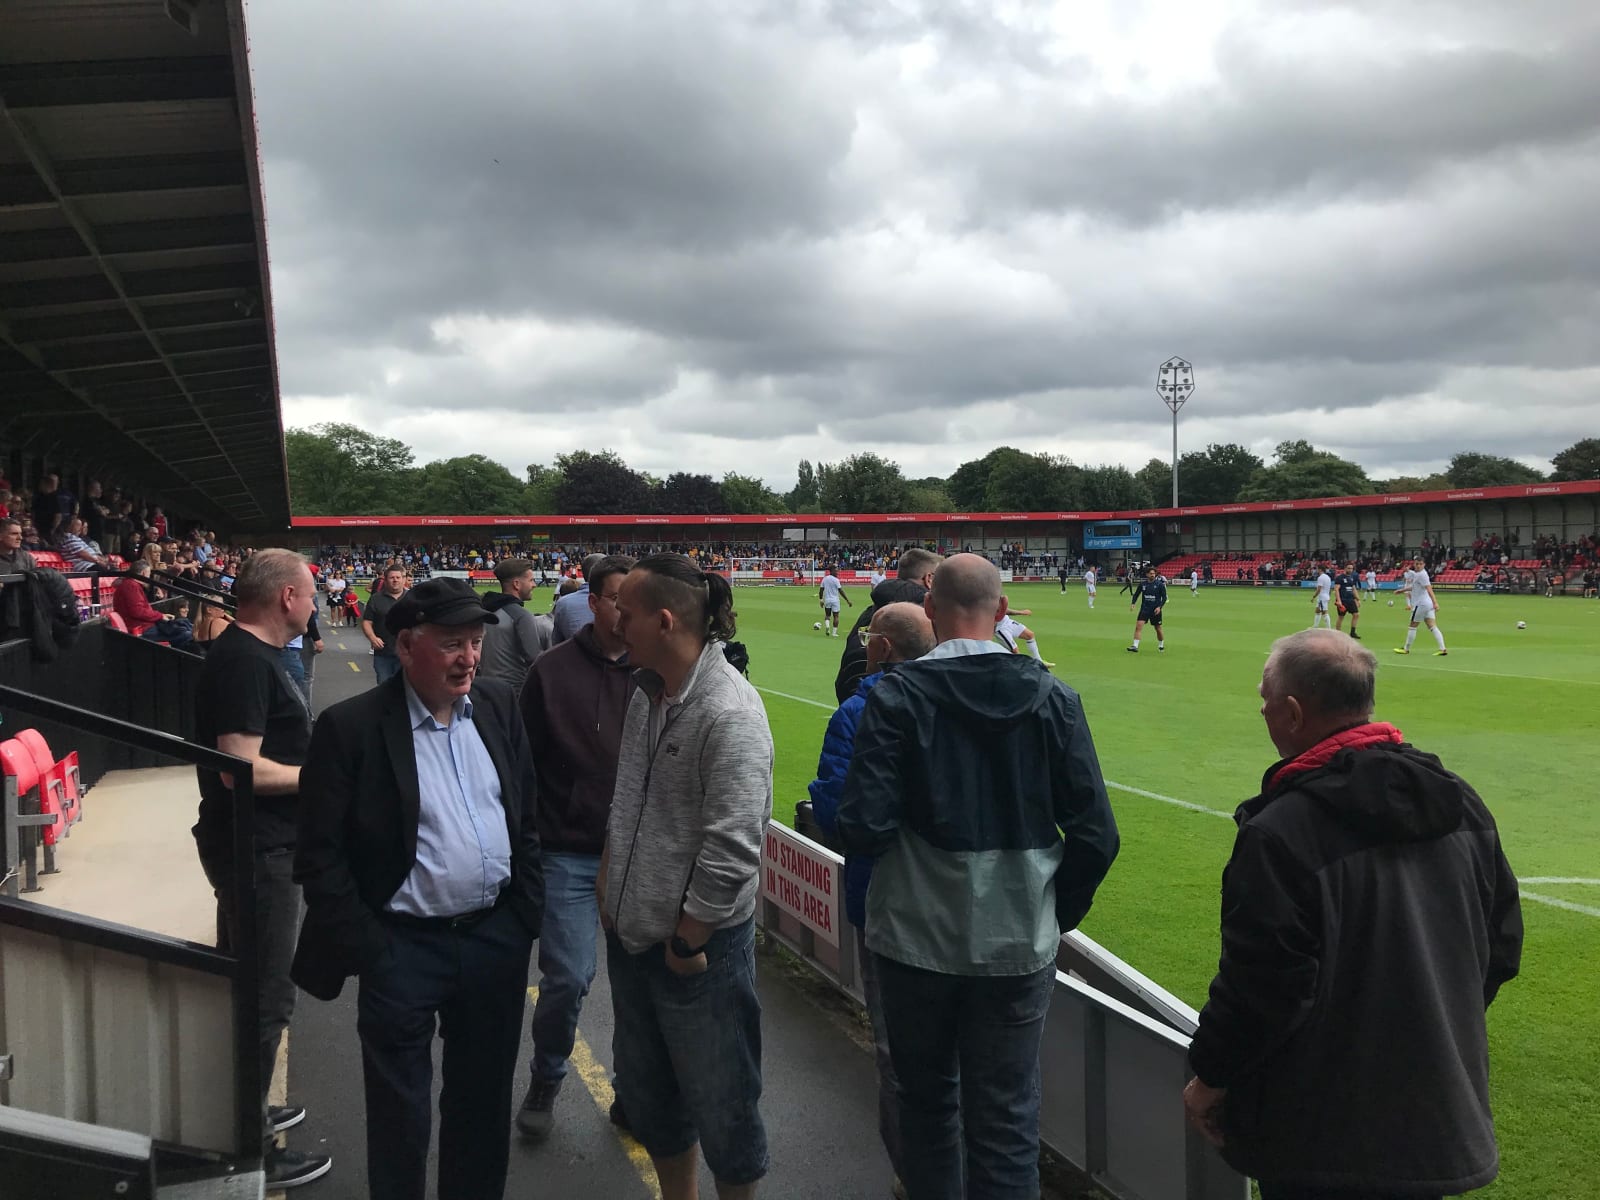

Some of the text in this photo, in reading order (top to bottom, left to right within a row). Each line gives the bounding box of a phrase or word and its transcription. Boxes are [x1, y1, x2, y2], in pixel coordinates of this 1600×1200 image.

[766, 833, 831, 895] NO STANDING
[767, 867, 831, 933] IN THIS AREA
